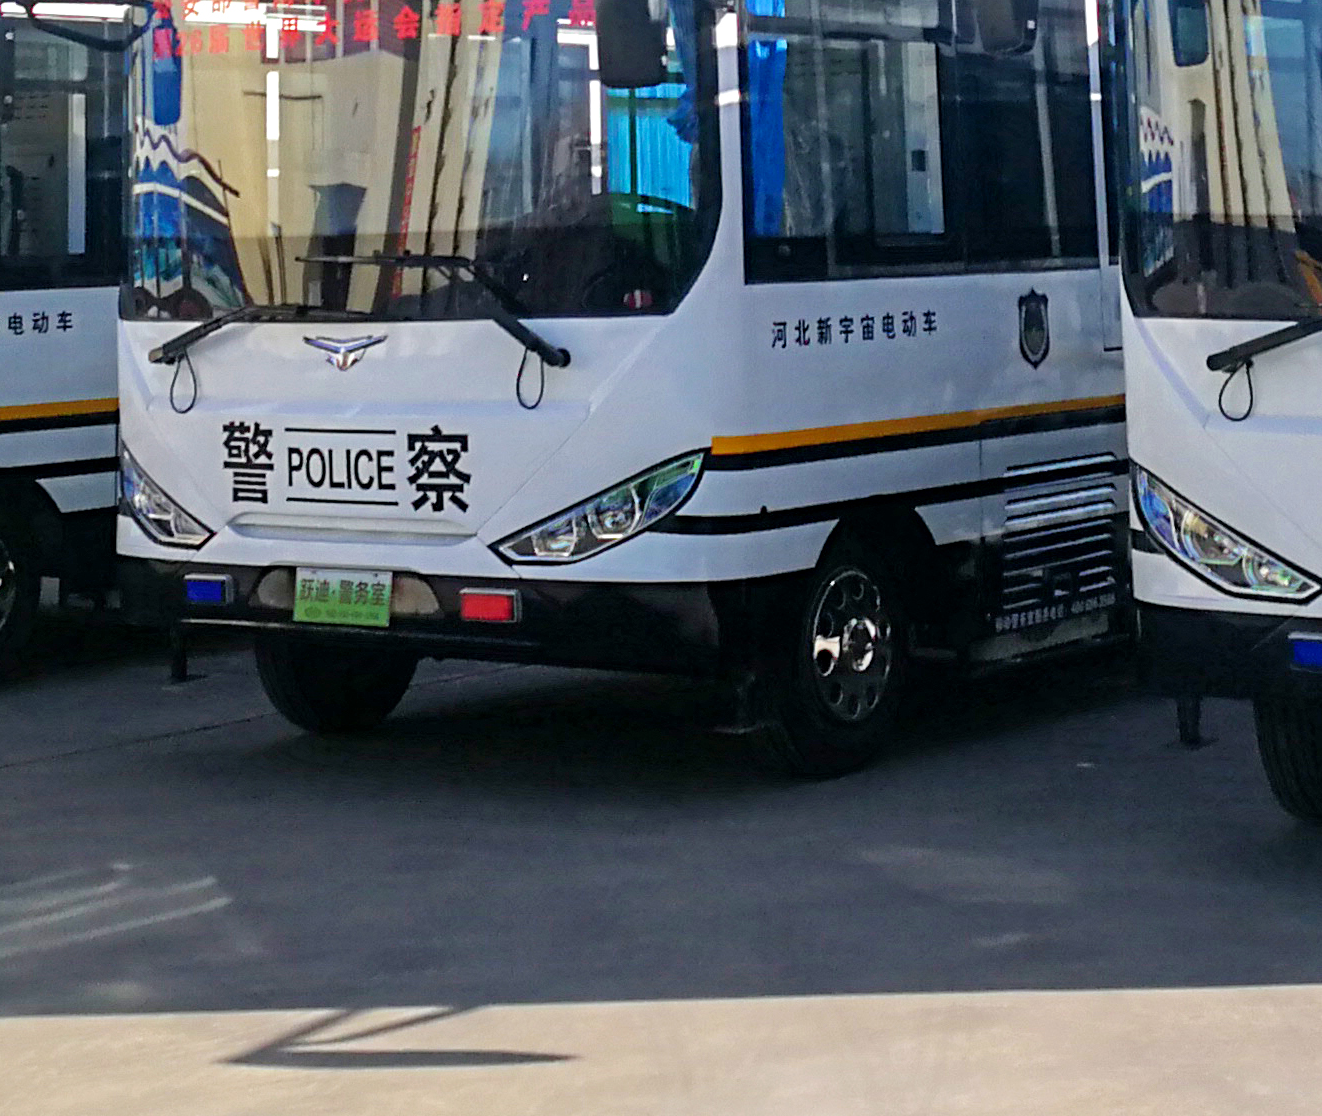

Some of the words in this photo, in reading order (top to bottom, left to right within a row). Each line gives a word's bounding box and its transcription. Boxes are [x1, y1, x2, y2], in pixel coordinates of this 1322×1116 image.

[772, 309, 937, 348] 河北新宇宙电动车
[222, 421, 274, 504] 警
[287, 447, 396, 490] POLICE
[407, 425, 472, 512] 察
